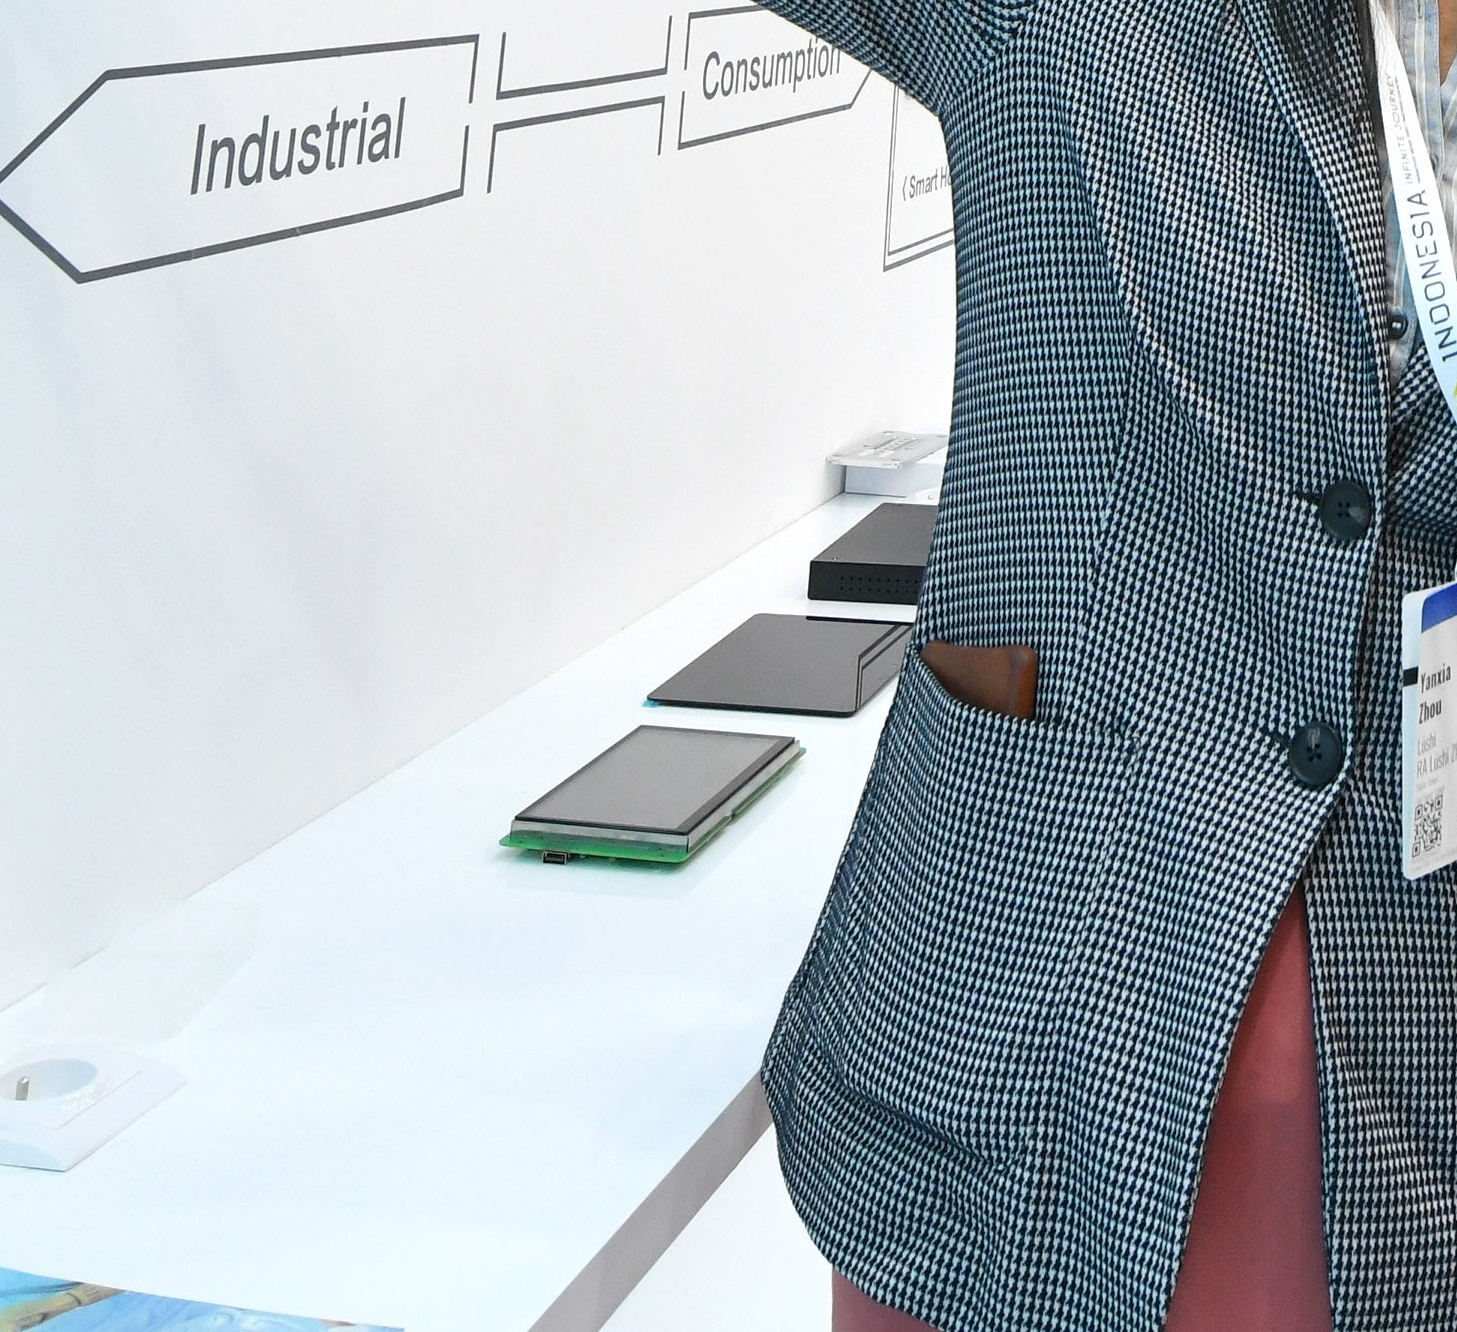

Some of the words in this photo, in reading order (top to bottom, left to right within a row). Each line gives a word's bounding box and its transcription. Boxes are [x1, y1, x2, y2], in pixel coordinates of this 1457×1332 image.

[702, 38, 842, 101] Consumption
[191, 97, 408, 198] Industrial
[909, 168, 938, 199] Smart
[1419, 663, 1451, 695] Yanxia
[1418, 698, 1443, 726] Zhou
